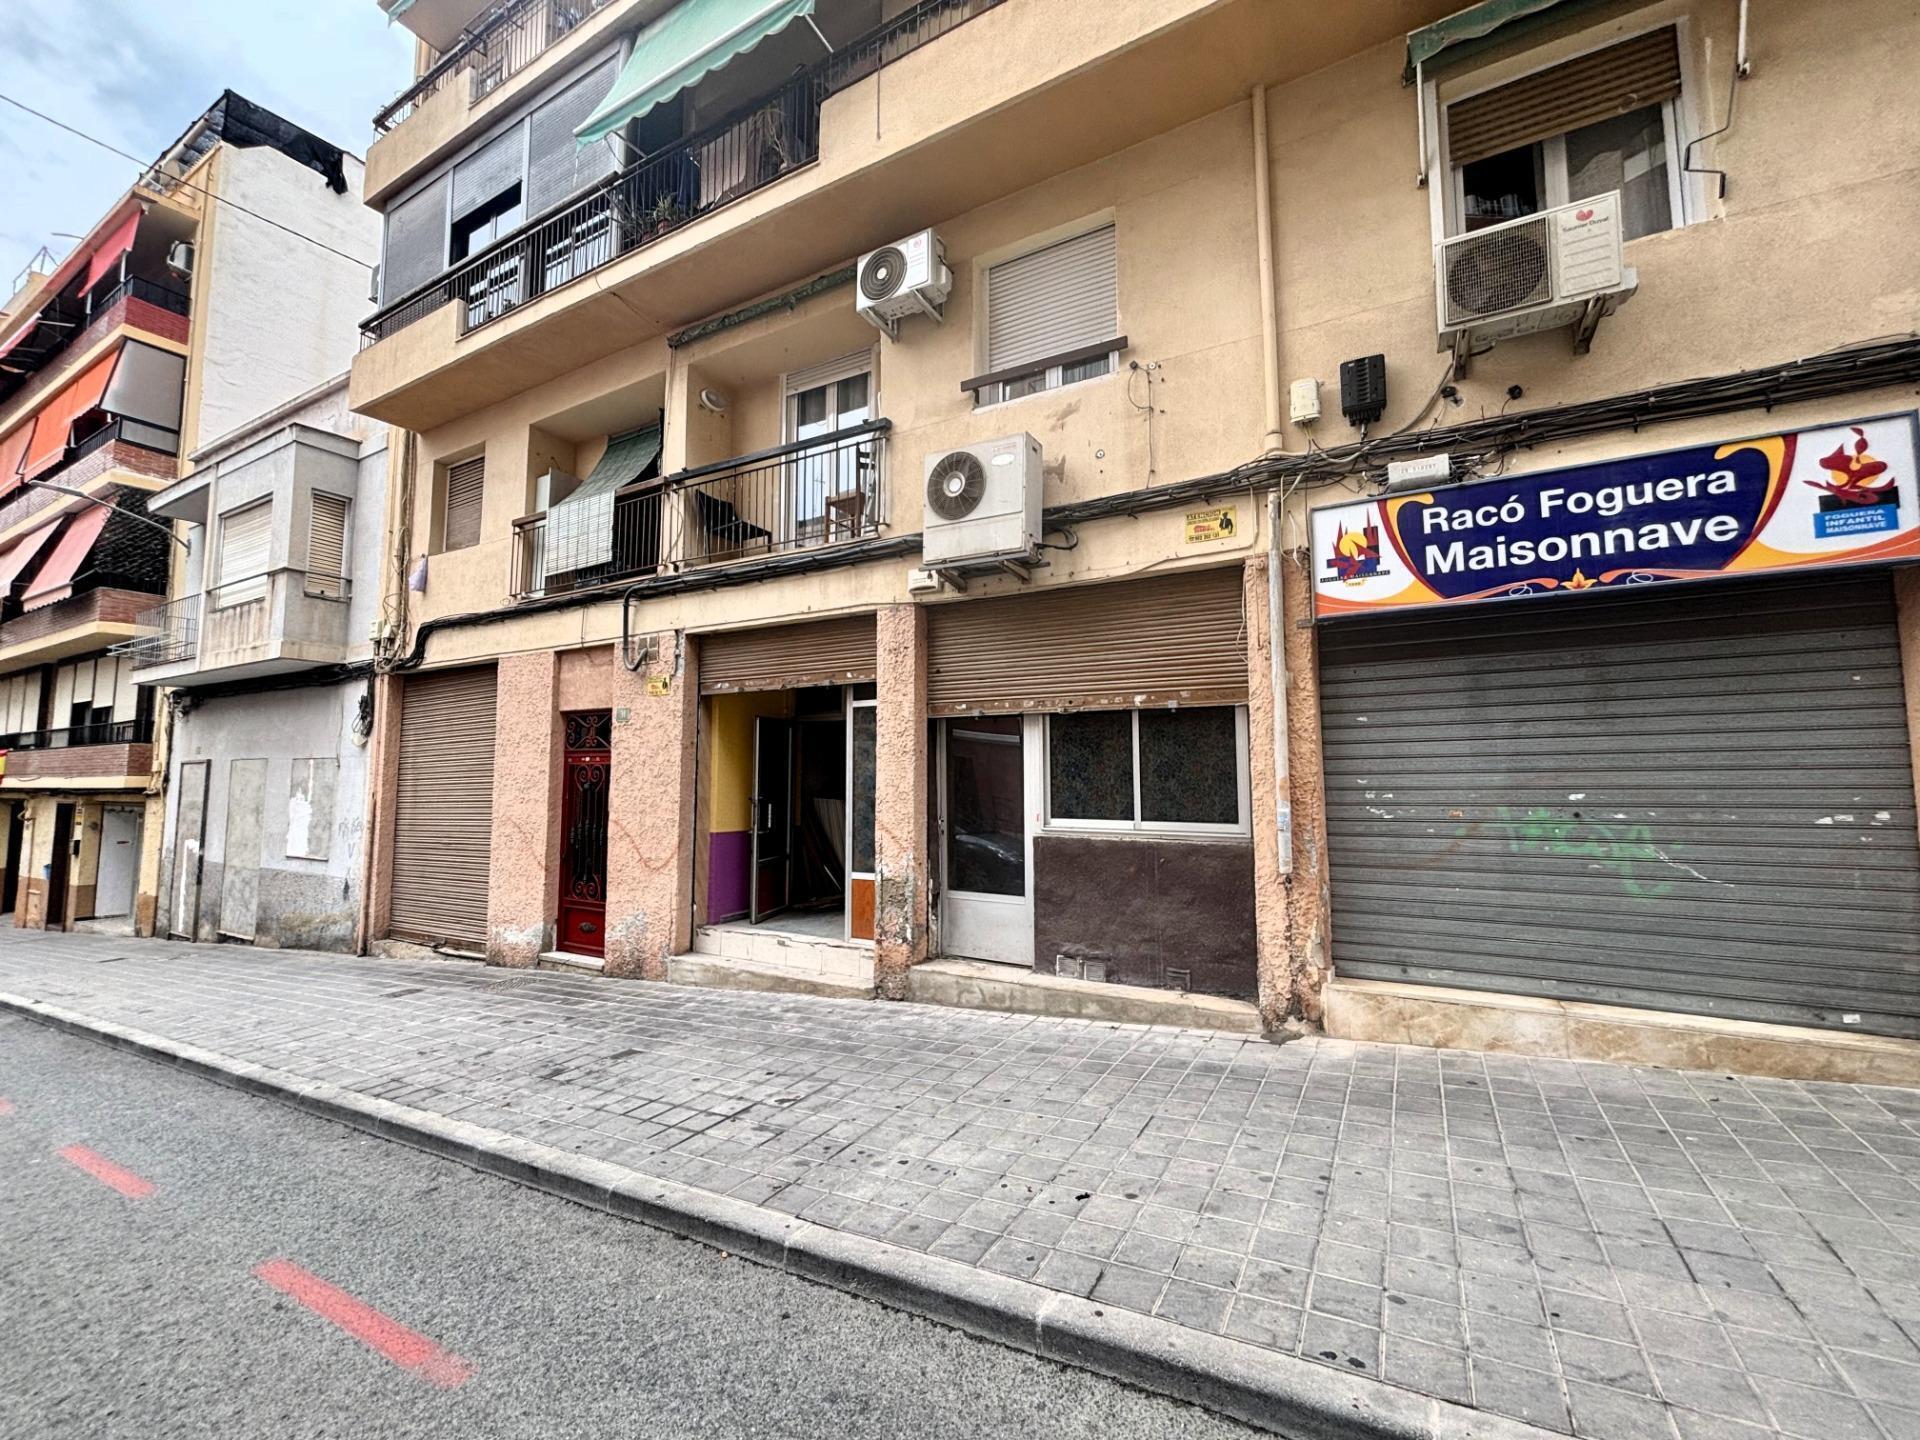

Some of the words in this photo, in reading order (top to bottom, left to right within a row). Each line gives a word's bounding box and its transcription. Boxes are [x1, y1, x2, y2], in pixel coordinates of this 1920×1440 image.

[1422, 494, 1525, 534] Racó
[1539, 470, 1736, 518] Foguera
[1825, 515, 1886, 527] INFANTIL
[1825, 521, 1887, 533] MAISONNAVE
[1425, 515, 1739, 575] Maisonnave
